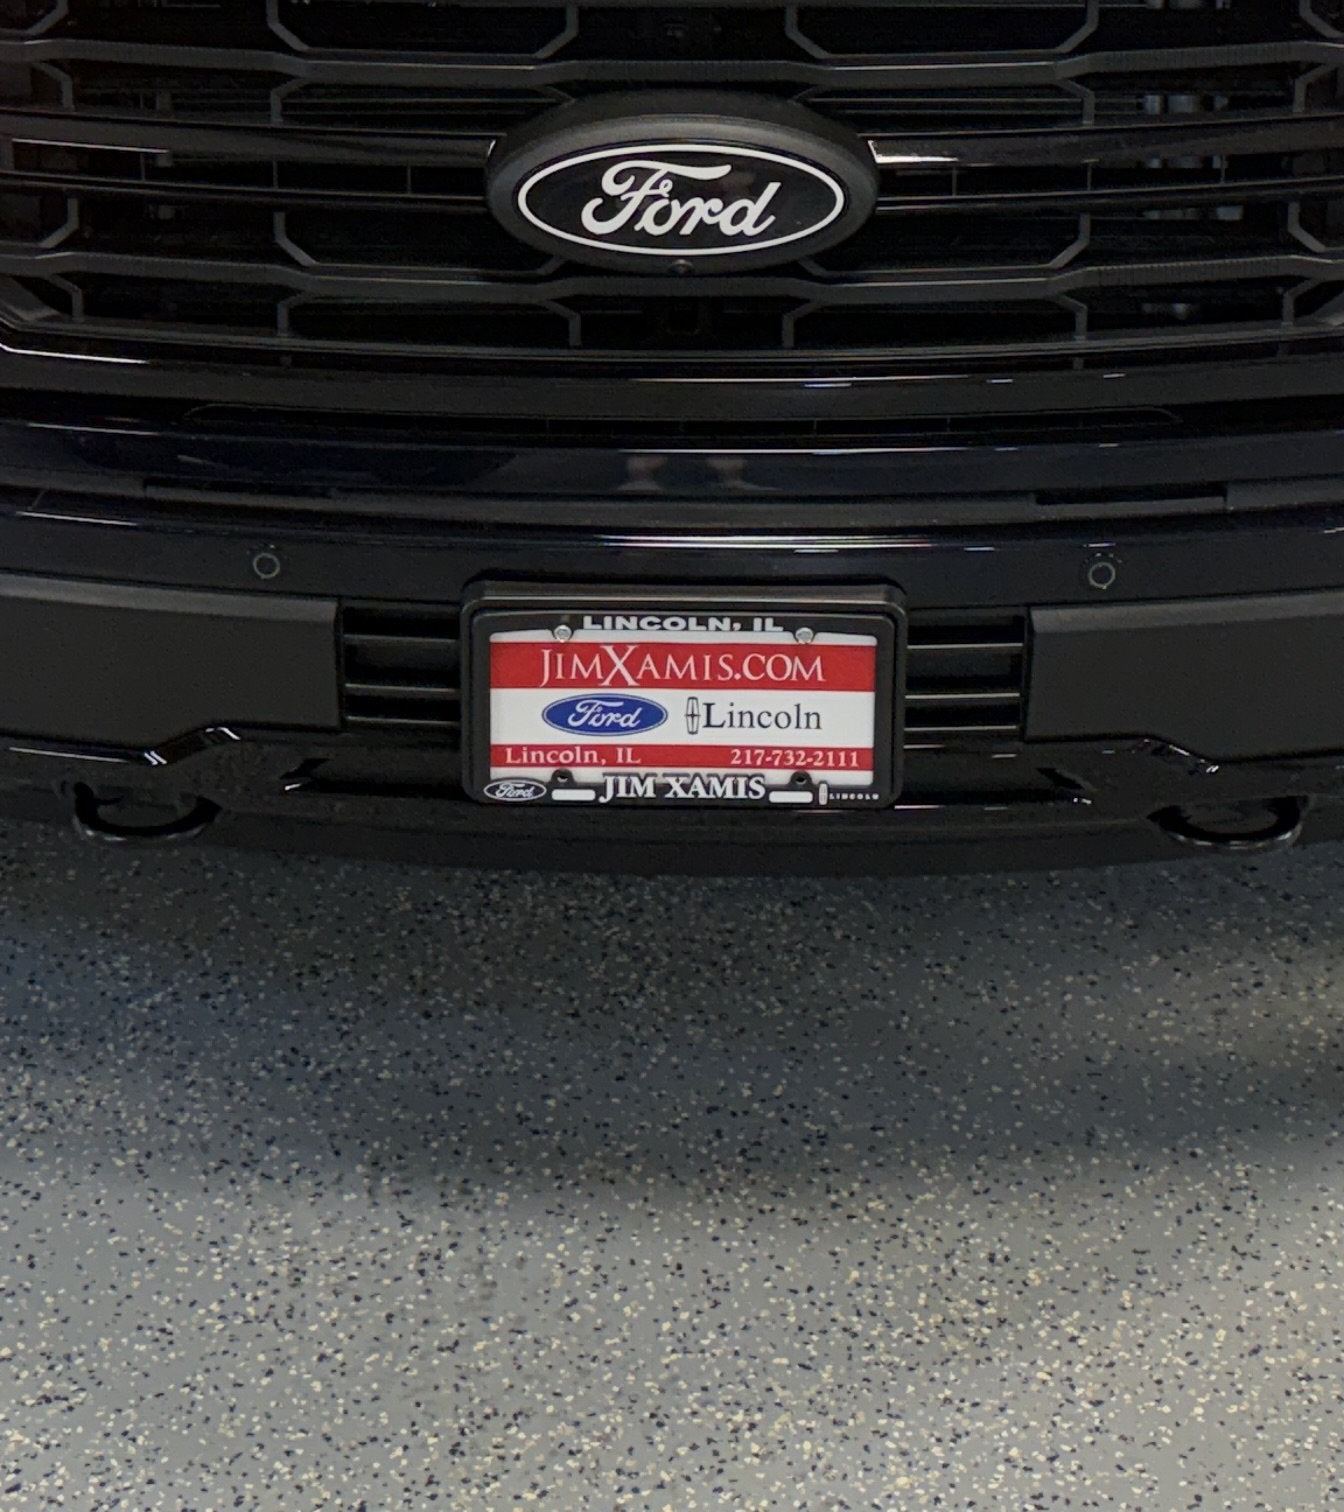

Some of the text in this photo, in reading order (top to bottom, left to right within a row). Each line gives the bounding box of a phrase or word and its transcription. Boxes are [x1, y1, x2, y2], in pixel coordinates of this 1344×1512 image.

[581, 160, 781, 237] Ford
[583, 615, 784, 632] LINCOLN, IL
[567, 699, 643, 727] Ford
[703, 701, 822, 730] Lincoln
[505, 746, 642, 766] Lincoln, IL
[730, 748, 859, 767] 217-732-2111
[495, 782, 536, 799] Ford
[598, 774, 766, 804] JIM XAMIS
[828, 793, 880, 801] LINCOLN
